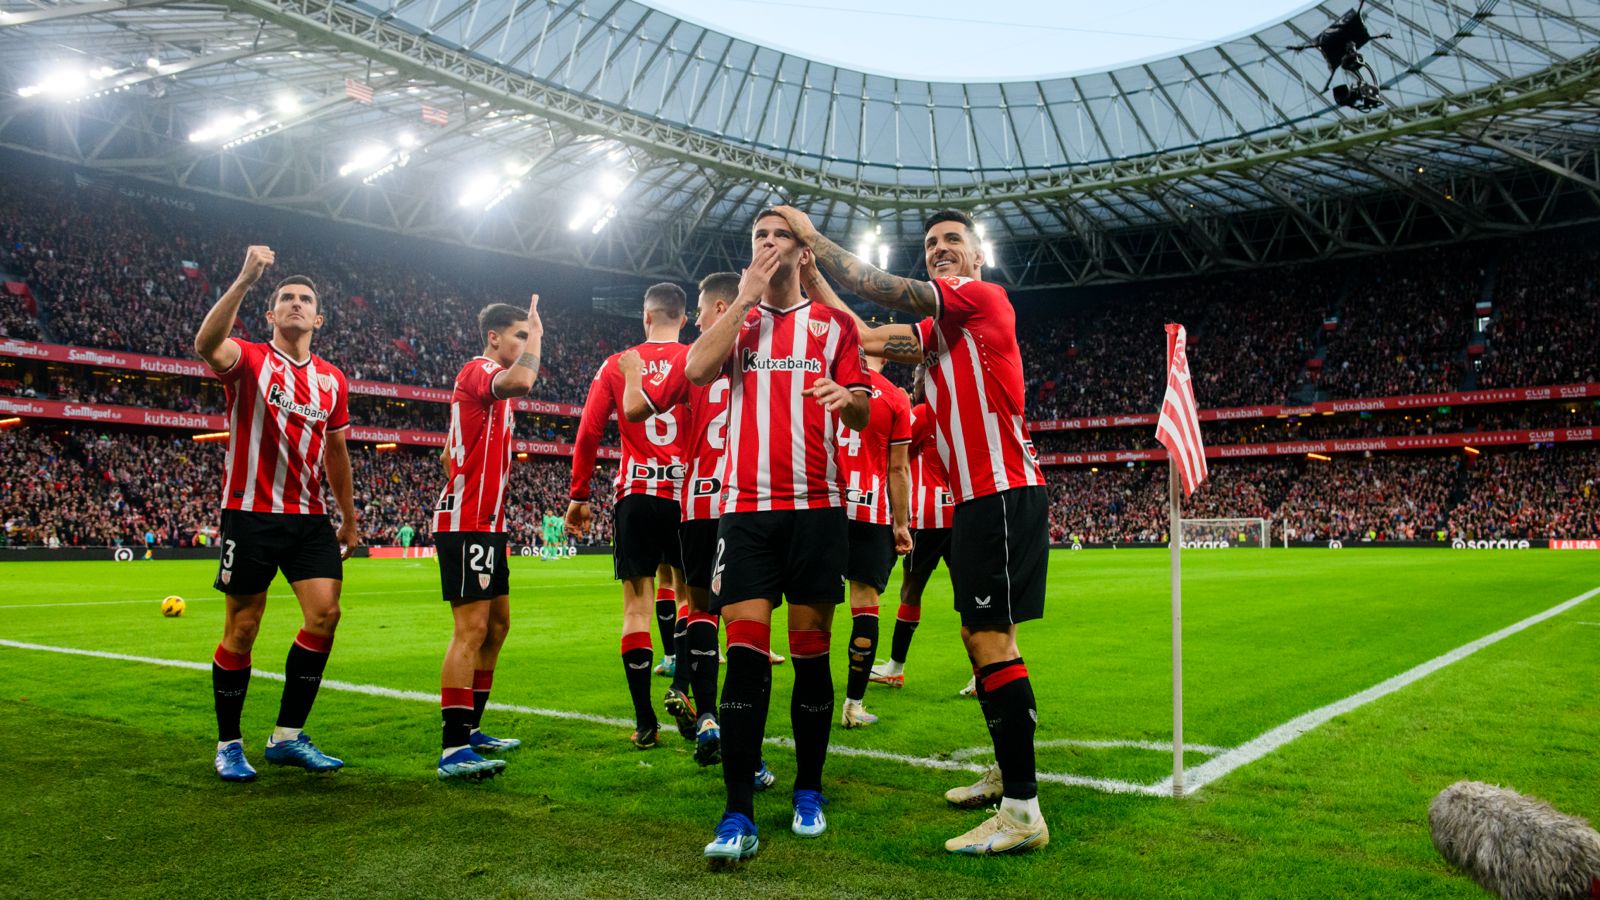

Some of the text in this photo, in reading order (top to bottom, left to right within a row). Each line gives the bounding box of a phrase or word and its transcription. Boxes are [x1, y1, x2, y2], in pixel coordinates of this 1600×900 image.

[742, 348, 821, 372] Kutxabank
[140, 358, 205, 376] kutxabank
[348, 382, 398, 396] kutxabank
[268, 383, 328, 421] Kutxabank
[530, 402, 560, 413] TOYOTA
[1333, 400, 1385, 411] kutxabank
[1216, 408, 1263, 419] kutxabank
[144, 412, 209, 427] kutxabank
[1062, 421, 1081, 429] IMQ
[1088, 419, 1107, 427] IMQ
[351, 428, 400, 442] kutxabank
[529, 442, 558, 453] TOYOTA
[1276, 444, 1327, 454] kutxabank
[1334, 440, 1387, 451] kutxabank
[1221, 446, 1268, 457] kutxabank
[1063, 456, 1082, 464] IMQ
[1088, 454, 1107, 462] IMQ
[632, 465, 686, 480] DIG
[223, 540, 236, 569] 3
[469, 544, 495, 574] 24
